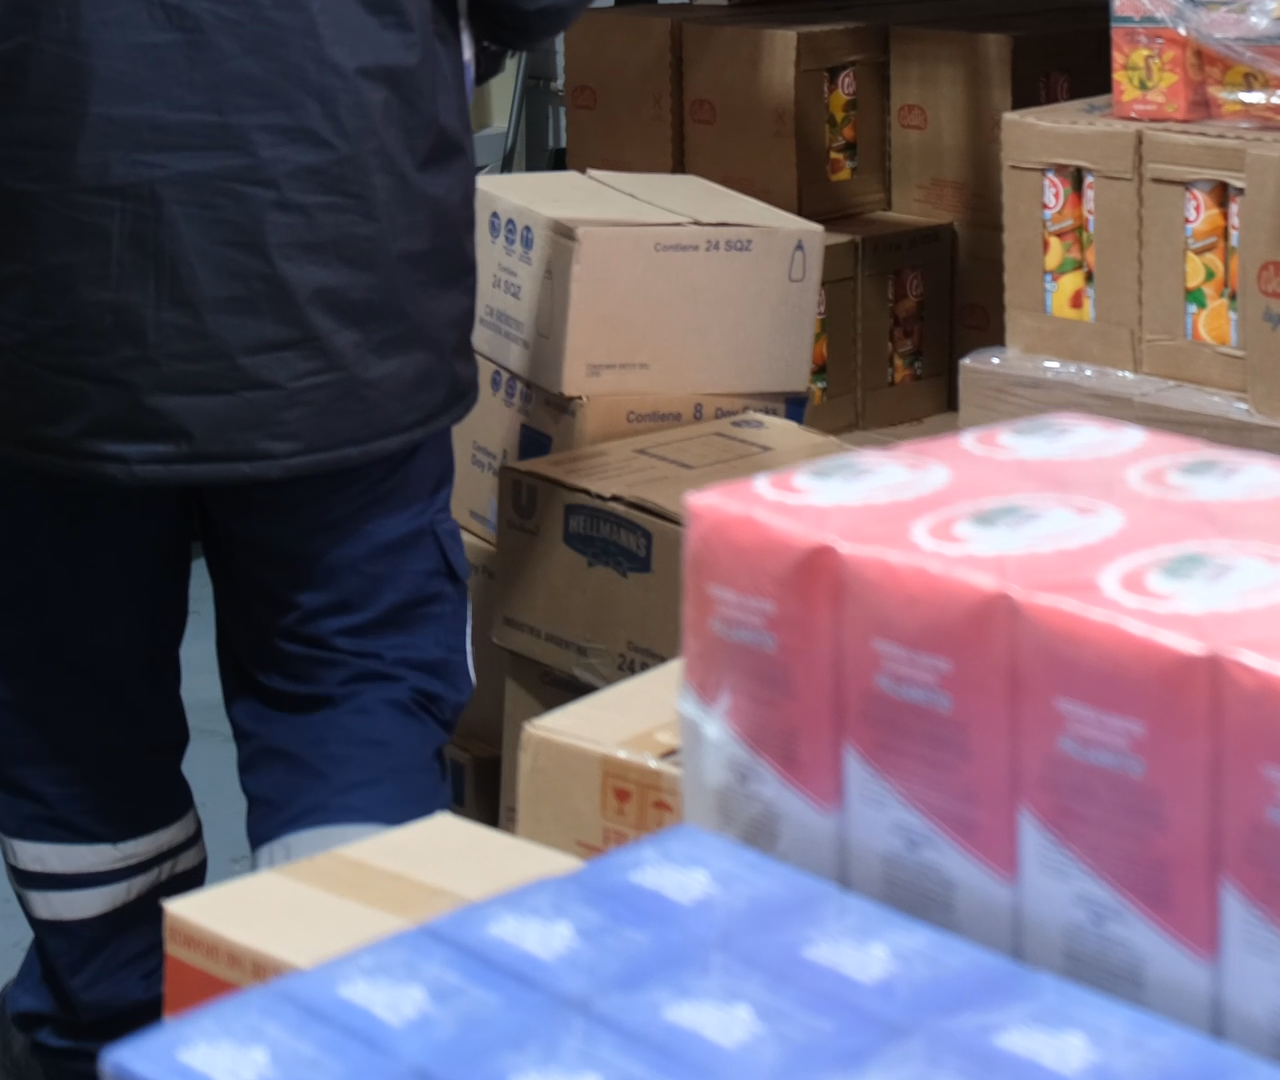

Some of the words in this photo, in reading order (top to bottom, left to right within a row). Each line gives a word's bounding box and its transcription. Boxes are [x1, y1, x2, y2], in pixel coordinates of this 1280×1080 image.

[653, 241, 700, 253] Contiene
[704, 239, 721, 253] 24
[723, 238, 754, 253] SQZ
[626, 410, 683, 425] Contiene
[692, 402, 704, 421] 8
